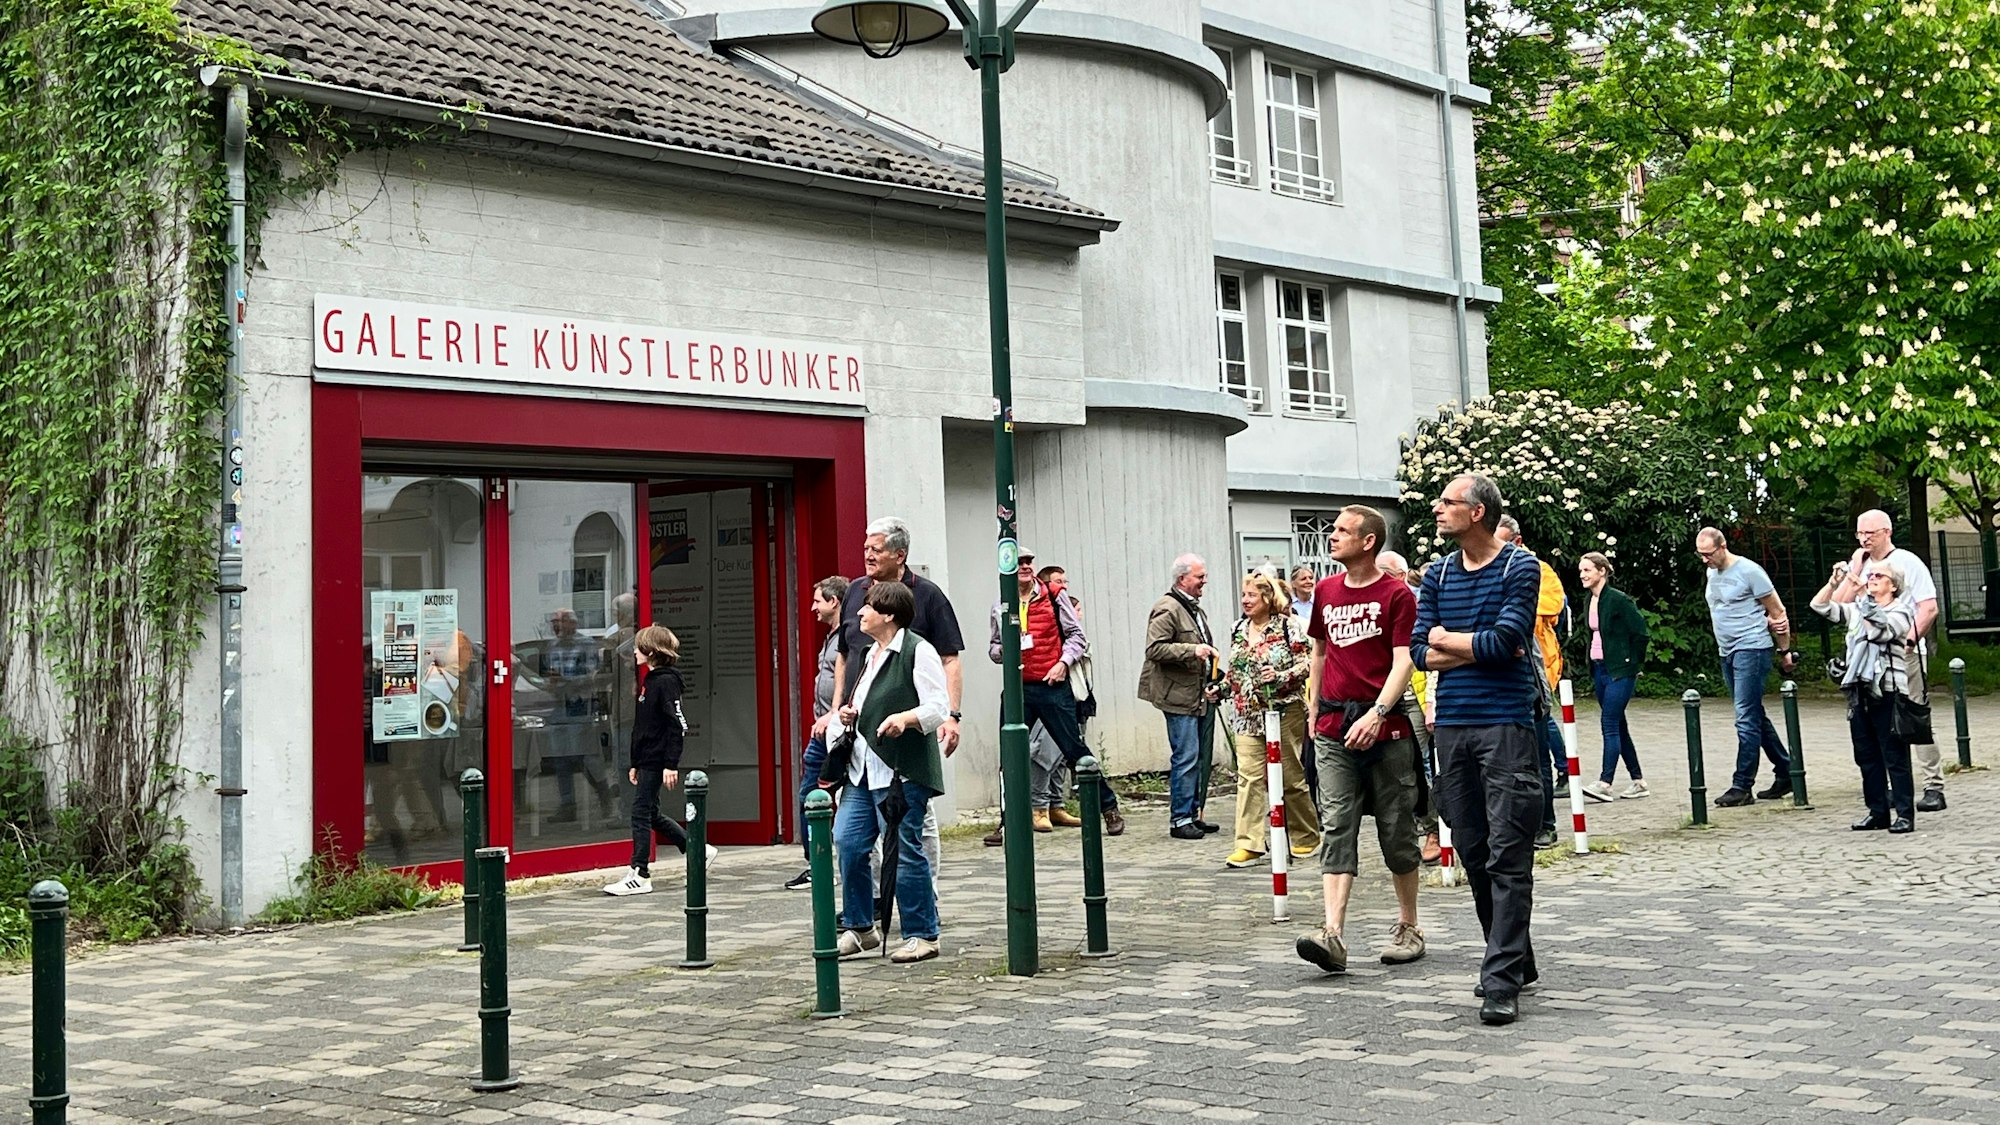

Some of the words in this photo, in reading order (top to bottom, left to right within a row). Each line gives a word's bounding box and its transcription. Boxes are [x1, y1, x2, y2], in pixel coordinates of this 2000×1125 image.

[322, 309, 508, 367] GALERIE
[533, 322, 861, 393] KÜNSTLERBUNKER
[424, 594, 454, 606] AKQUISE
[1322, 602, 1369, 625] Bayer
[1328, 618, 1381, 644] Giants
